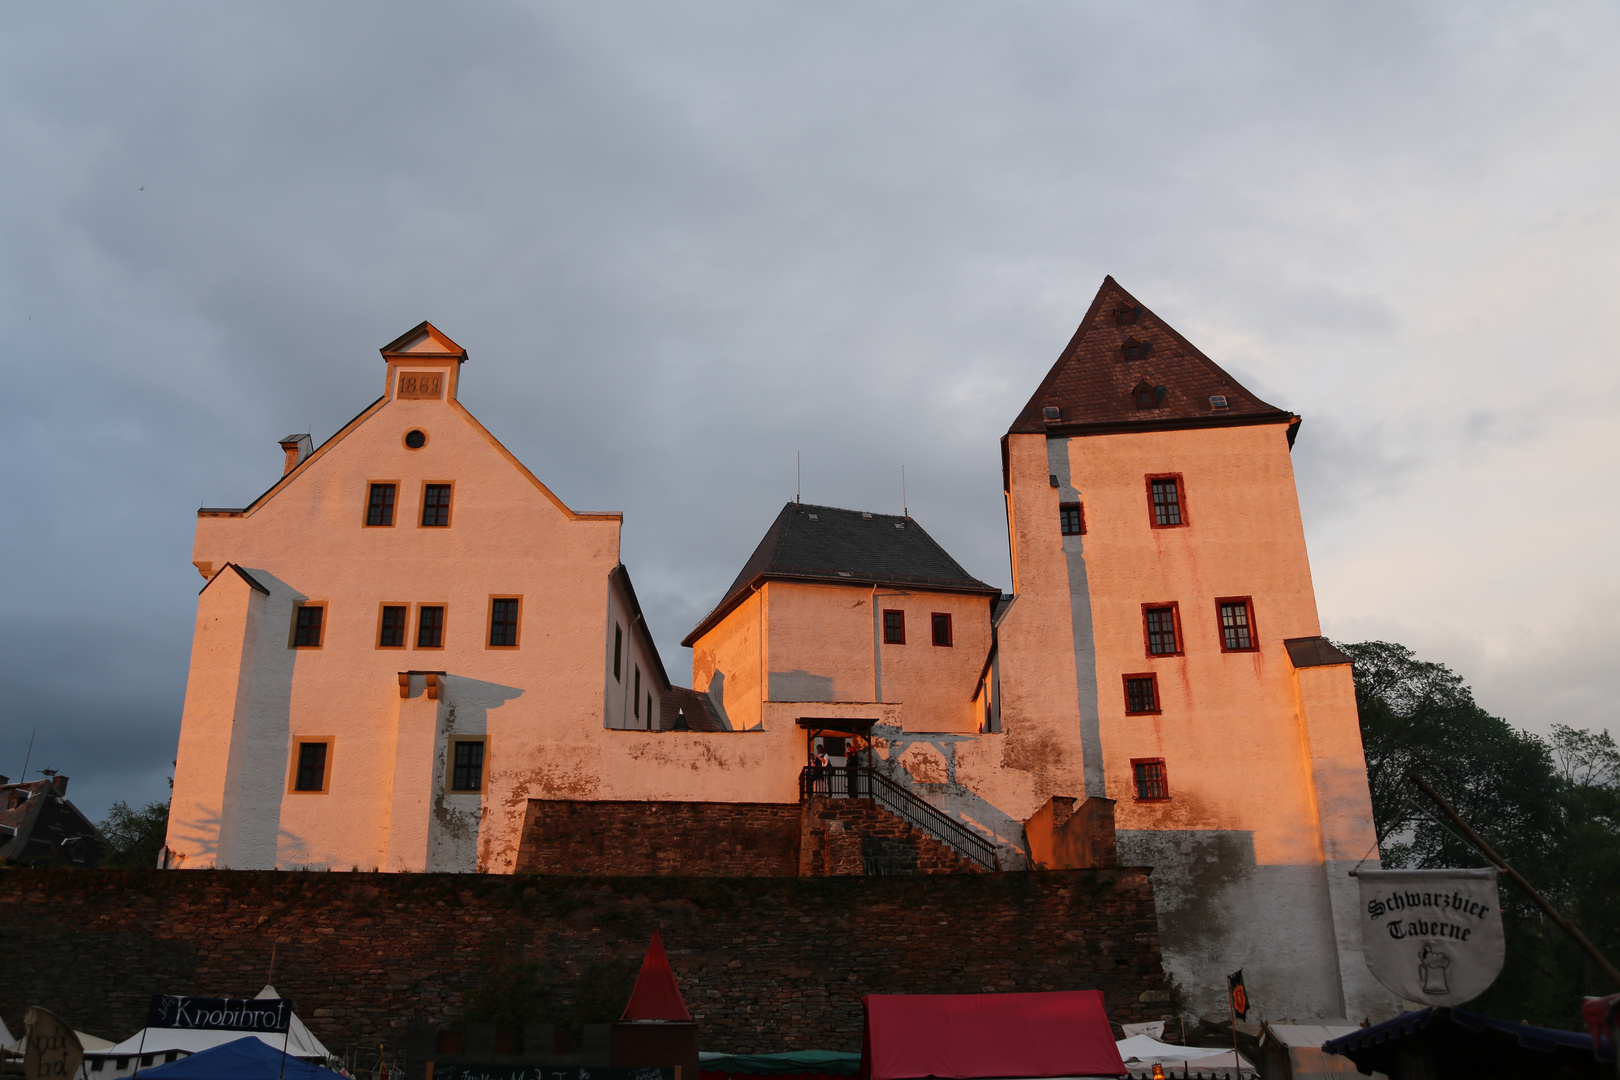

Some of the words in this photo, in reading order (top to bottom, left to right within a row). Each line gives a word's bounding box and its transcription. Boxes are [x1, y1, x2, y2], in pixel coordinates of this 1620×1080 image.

[1367, 889, 1490, 920] Schwarzbier
[1386, 918, 1472, 942] Taverne
[168, 995, 286, 1030] Knobibrot
[37, 1052, 69, 1077] brot
